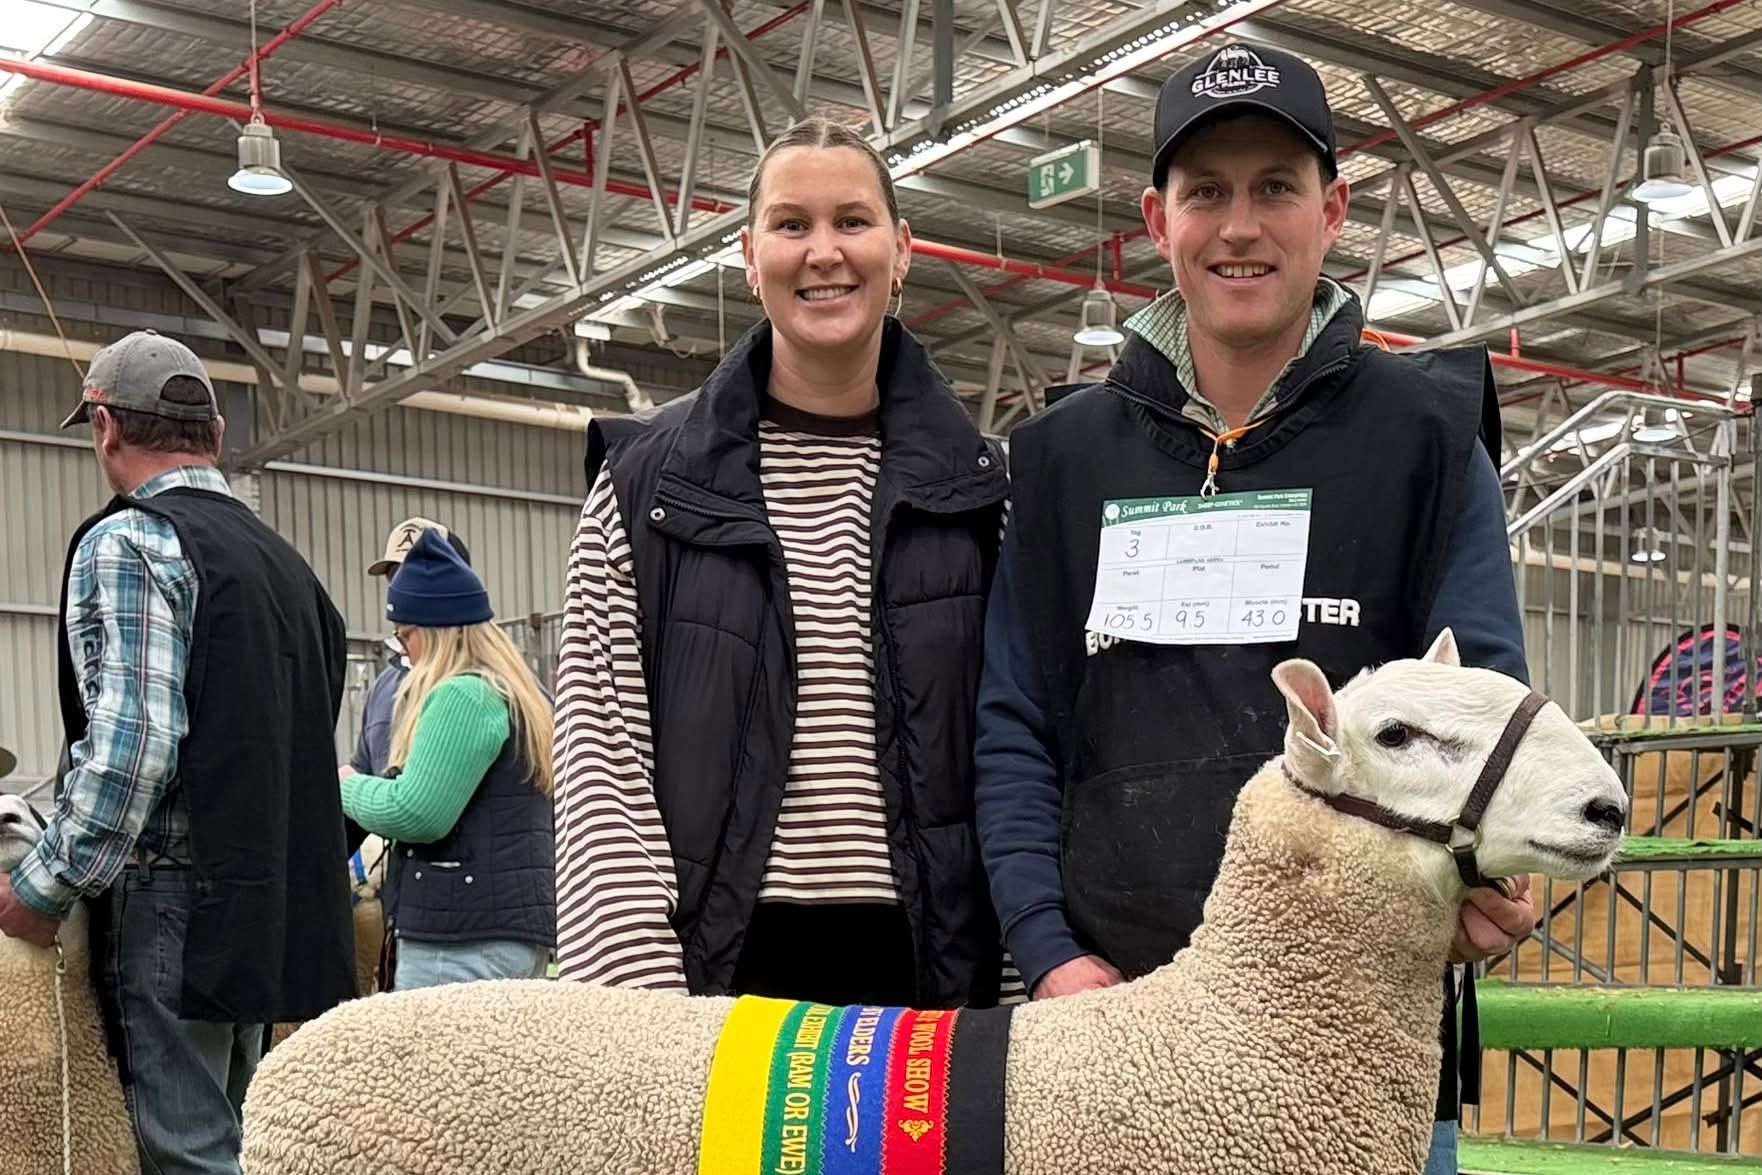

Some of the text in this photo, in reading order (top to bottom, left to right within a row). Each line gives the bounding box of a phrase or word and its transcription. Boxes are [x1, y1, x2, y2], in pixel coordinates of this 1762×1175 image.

[1191, 68, 1280, 93] GLENLEE
[1120, 499, 1188, 518] Summit Park
[1124, 538, 1140, 558] 3
[846, 1016, 880, 1066] ELDERS
[908, 1022, 938, 1056] WOOL
[786, 1051, 817, 1089] (RAM
[903, 1057, 932, 1114] SHOW
[784, 1092, 811, 1121] OR
[774, 1124, 808, 1175] EWE)
